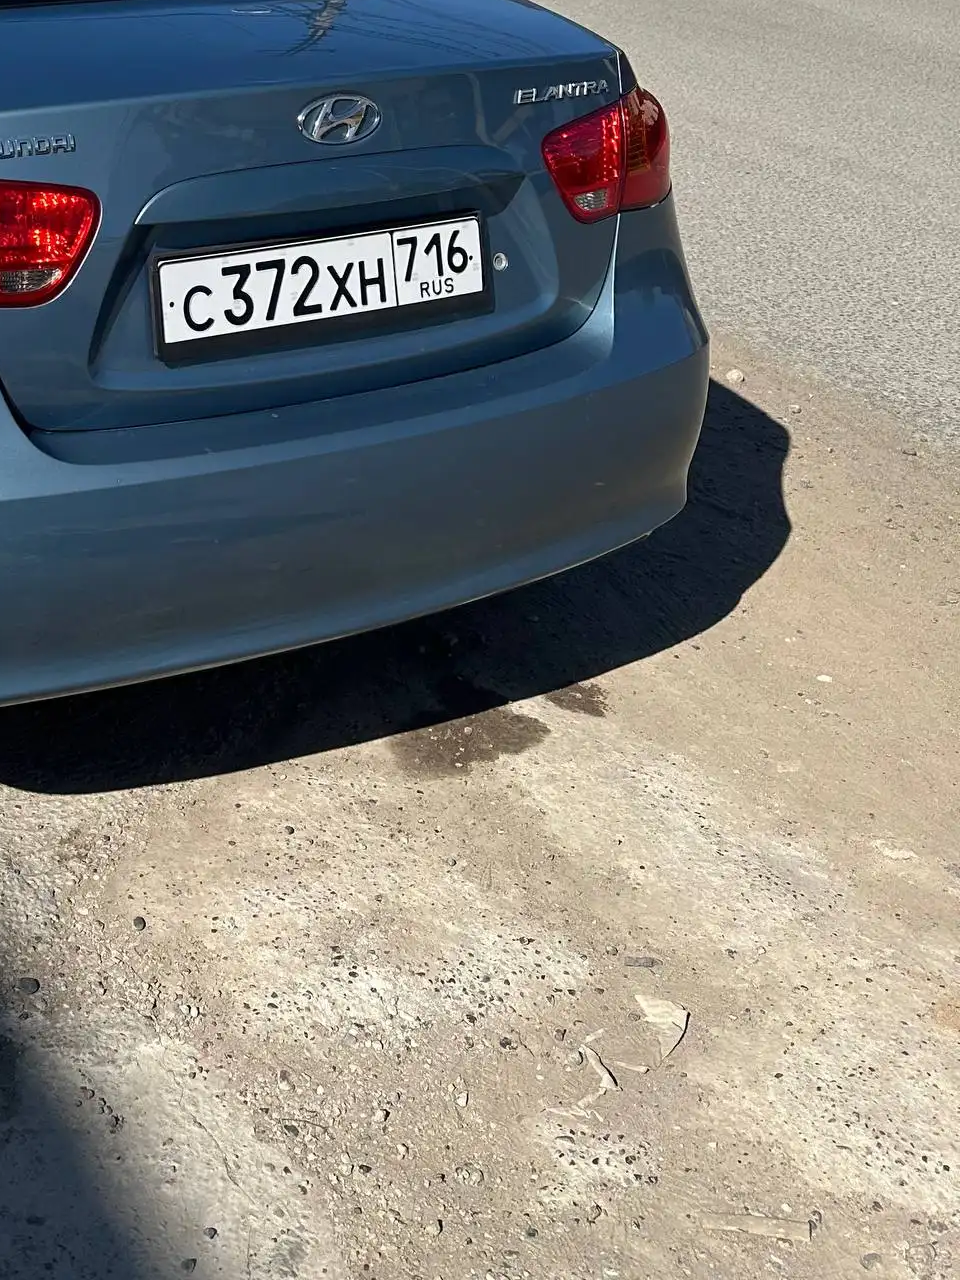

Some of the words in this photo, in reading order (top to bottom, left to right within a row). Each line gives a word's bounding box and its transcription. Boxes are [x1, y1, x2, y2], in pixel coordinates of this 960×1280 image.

[513, 79, 609, 105] ELANTRA
[396, 230, 469, 283] 716
[419, 277, 455, 299] RUS
